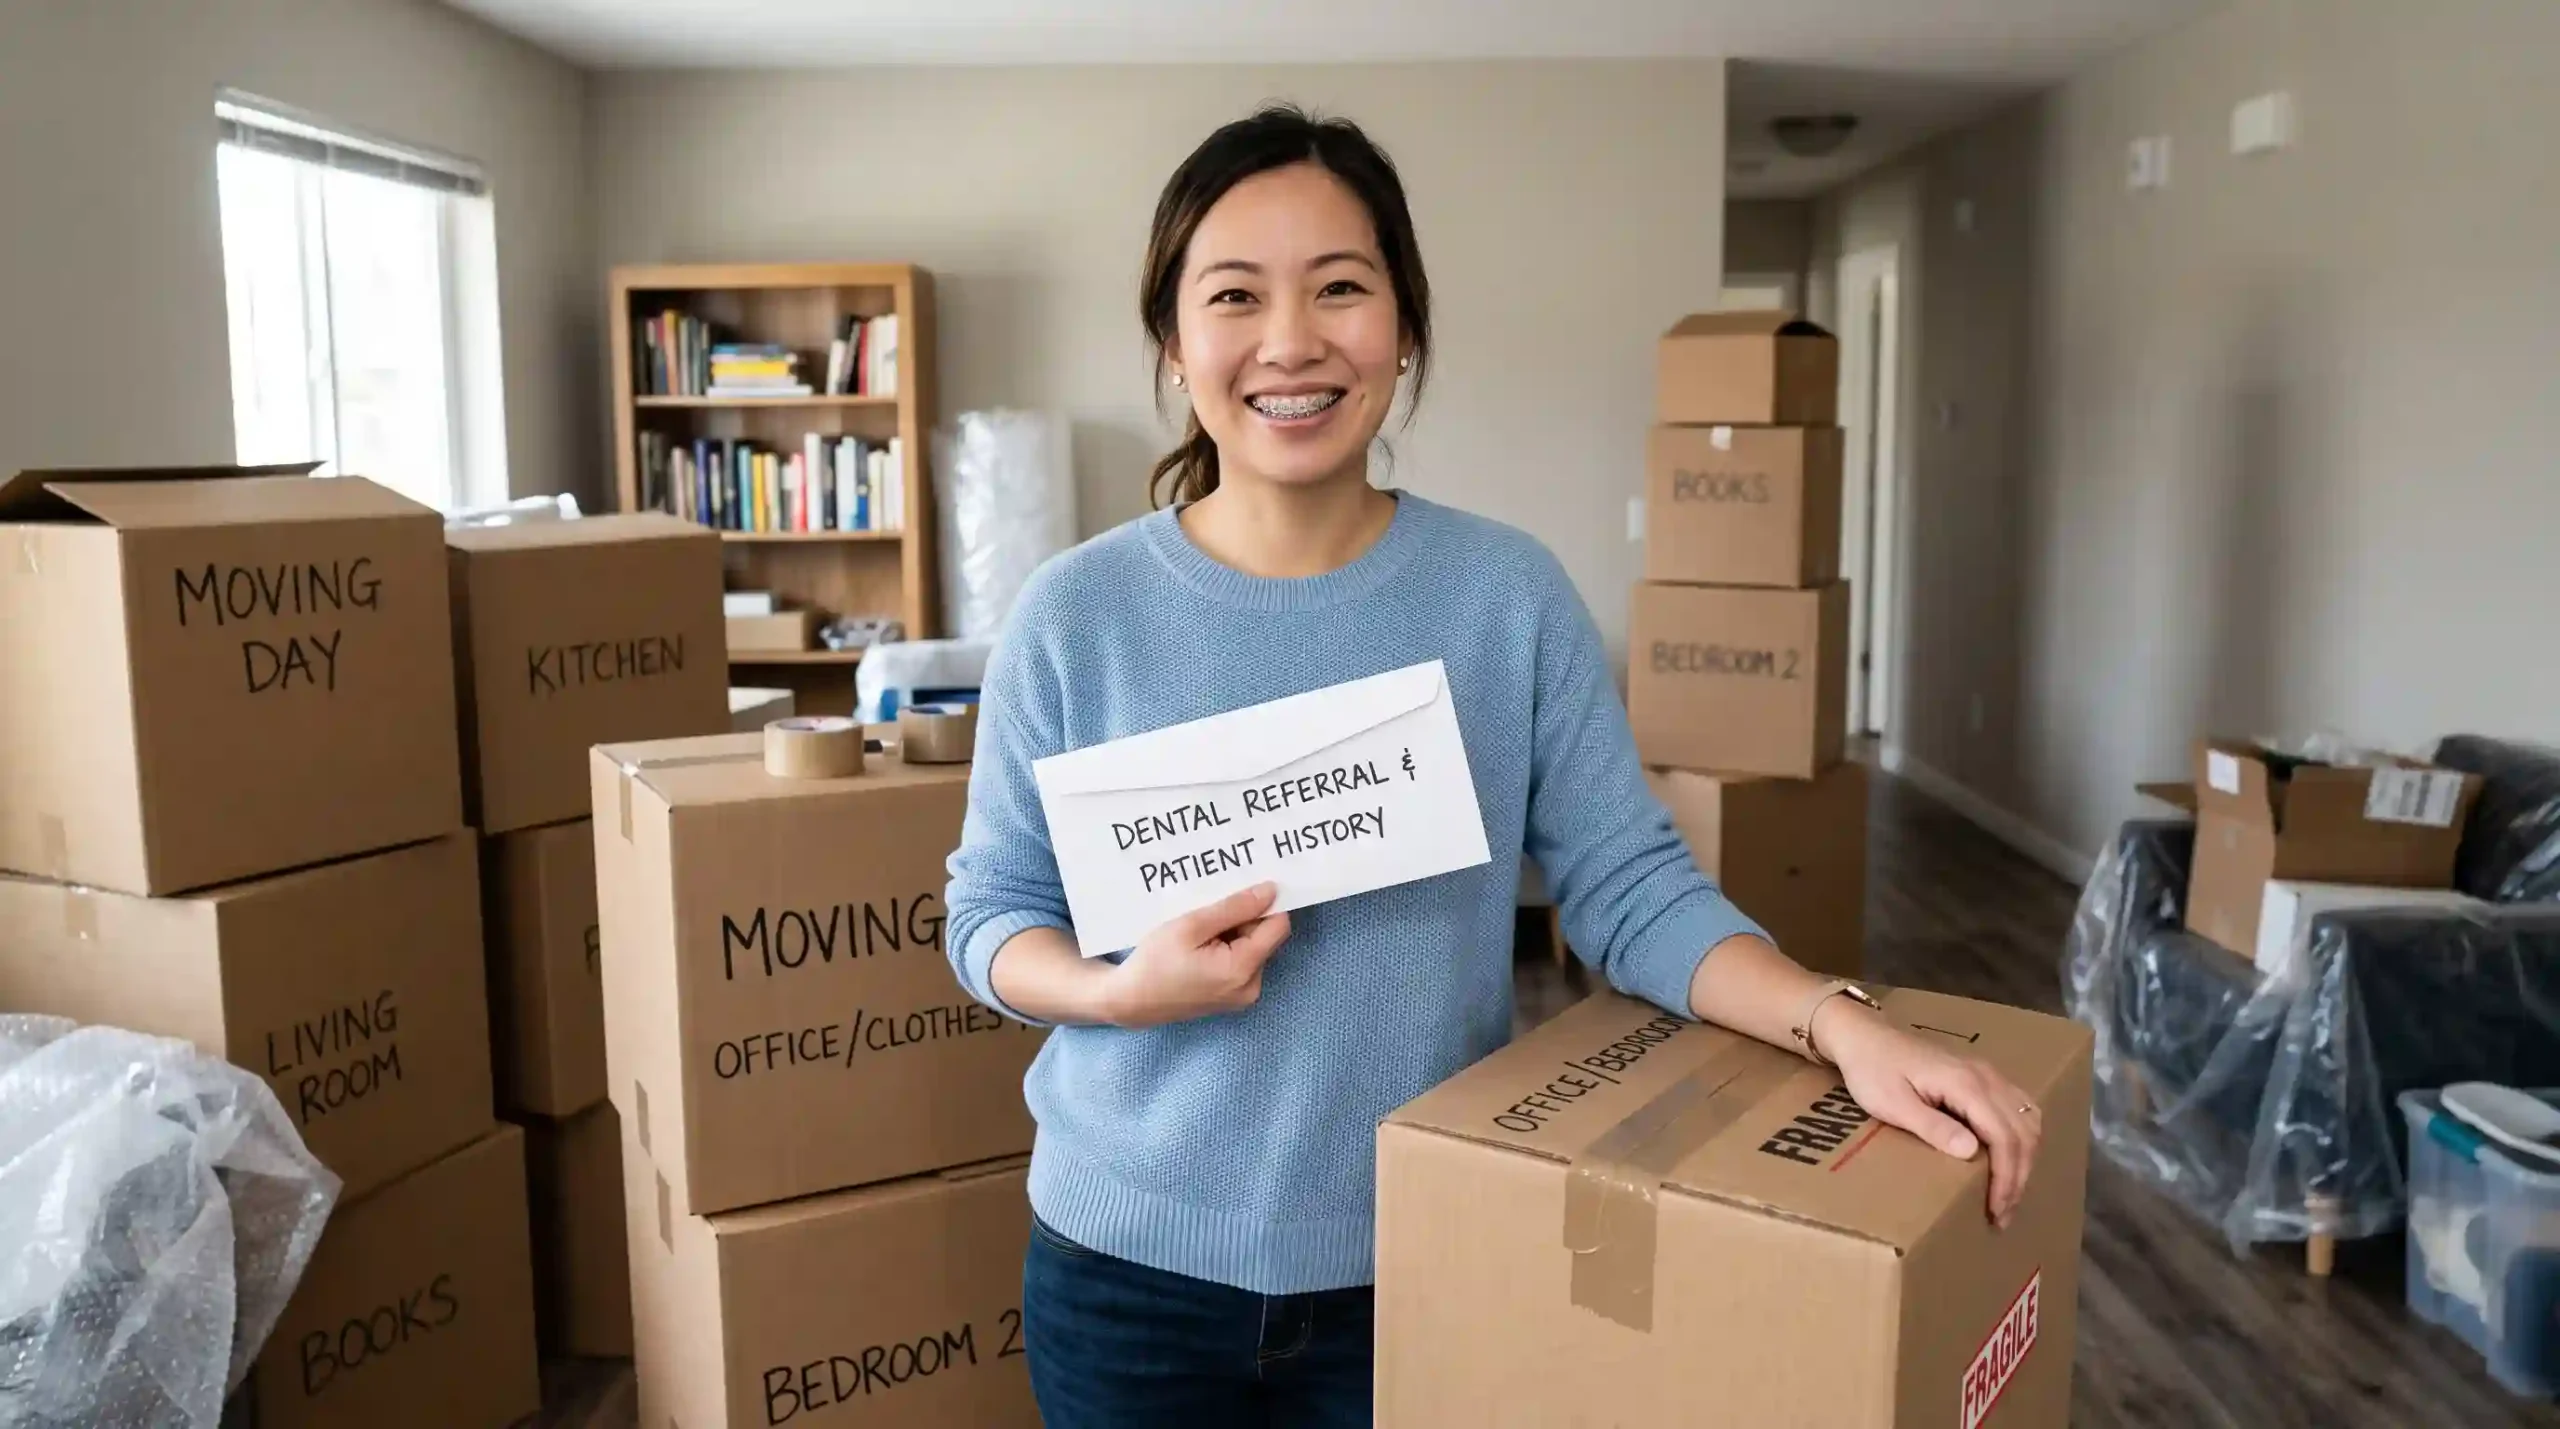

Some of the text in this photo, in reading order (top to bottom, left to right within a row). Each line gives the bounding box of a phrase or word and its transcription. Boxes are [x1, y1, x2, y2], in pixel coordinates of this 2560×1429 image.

[1673, 468, 1769, 503] BOOKS
[175, 557, 382, 627] MOVING
[242, 629, 341, 693] DAY
[528, 633, 683, 695] KITCHEN
[1652, 640, 1800, 680] BEDROOM 2
[1111, 747, 1416, 851] DENTAL REFERRAL &
[1139, 806, 1385, 892] PATIENT HISTORY
[722, 893, 946, 980] MOVING
[266, 989, 397, 1077] LIVING
[714, 1003, 1004, 1079] OFFICE/CLOTHES
[299, 1043, 402, 1125] ROOM
[301, 1273, 458, 1397] BOOKS
[763, 1308, 1026, 1426] BEDROOM 2
[1963, 1284, 2038, 1429] FRAGILE
